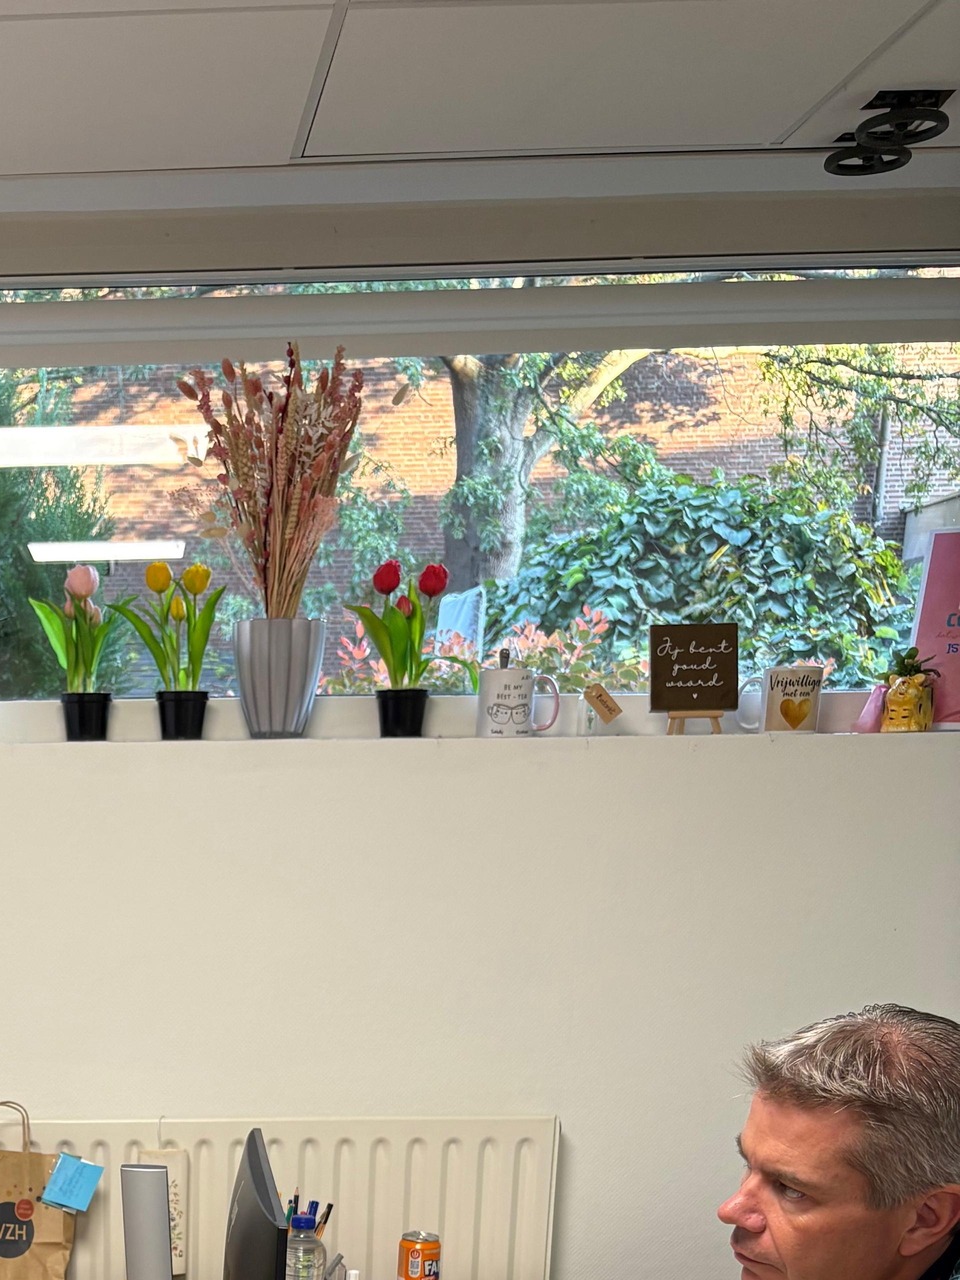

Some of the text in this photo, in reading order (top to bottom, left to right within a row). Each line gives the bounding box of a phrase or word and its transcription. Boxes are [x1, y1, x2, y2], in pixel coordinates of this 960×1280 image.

[690, 639, 733, 655] bent
[672, 656, 717, 677] goud
[665, 672, 724, 688] waard
[782, 690, 811, 699] met een
